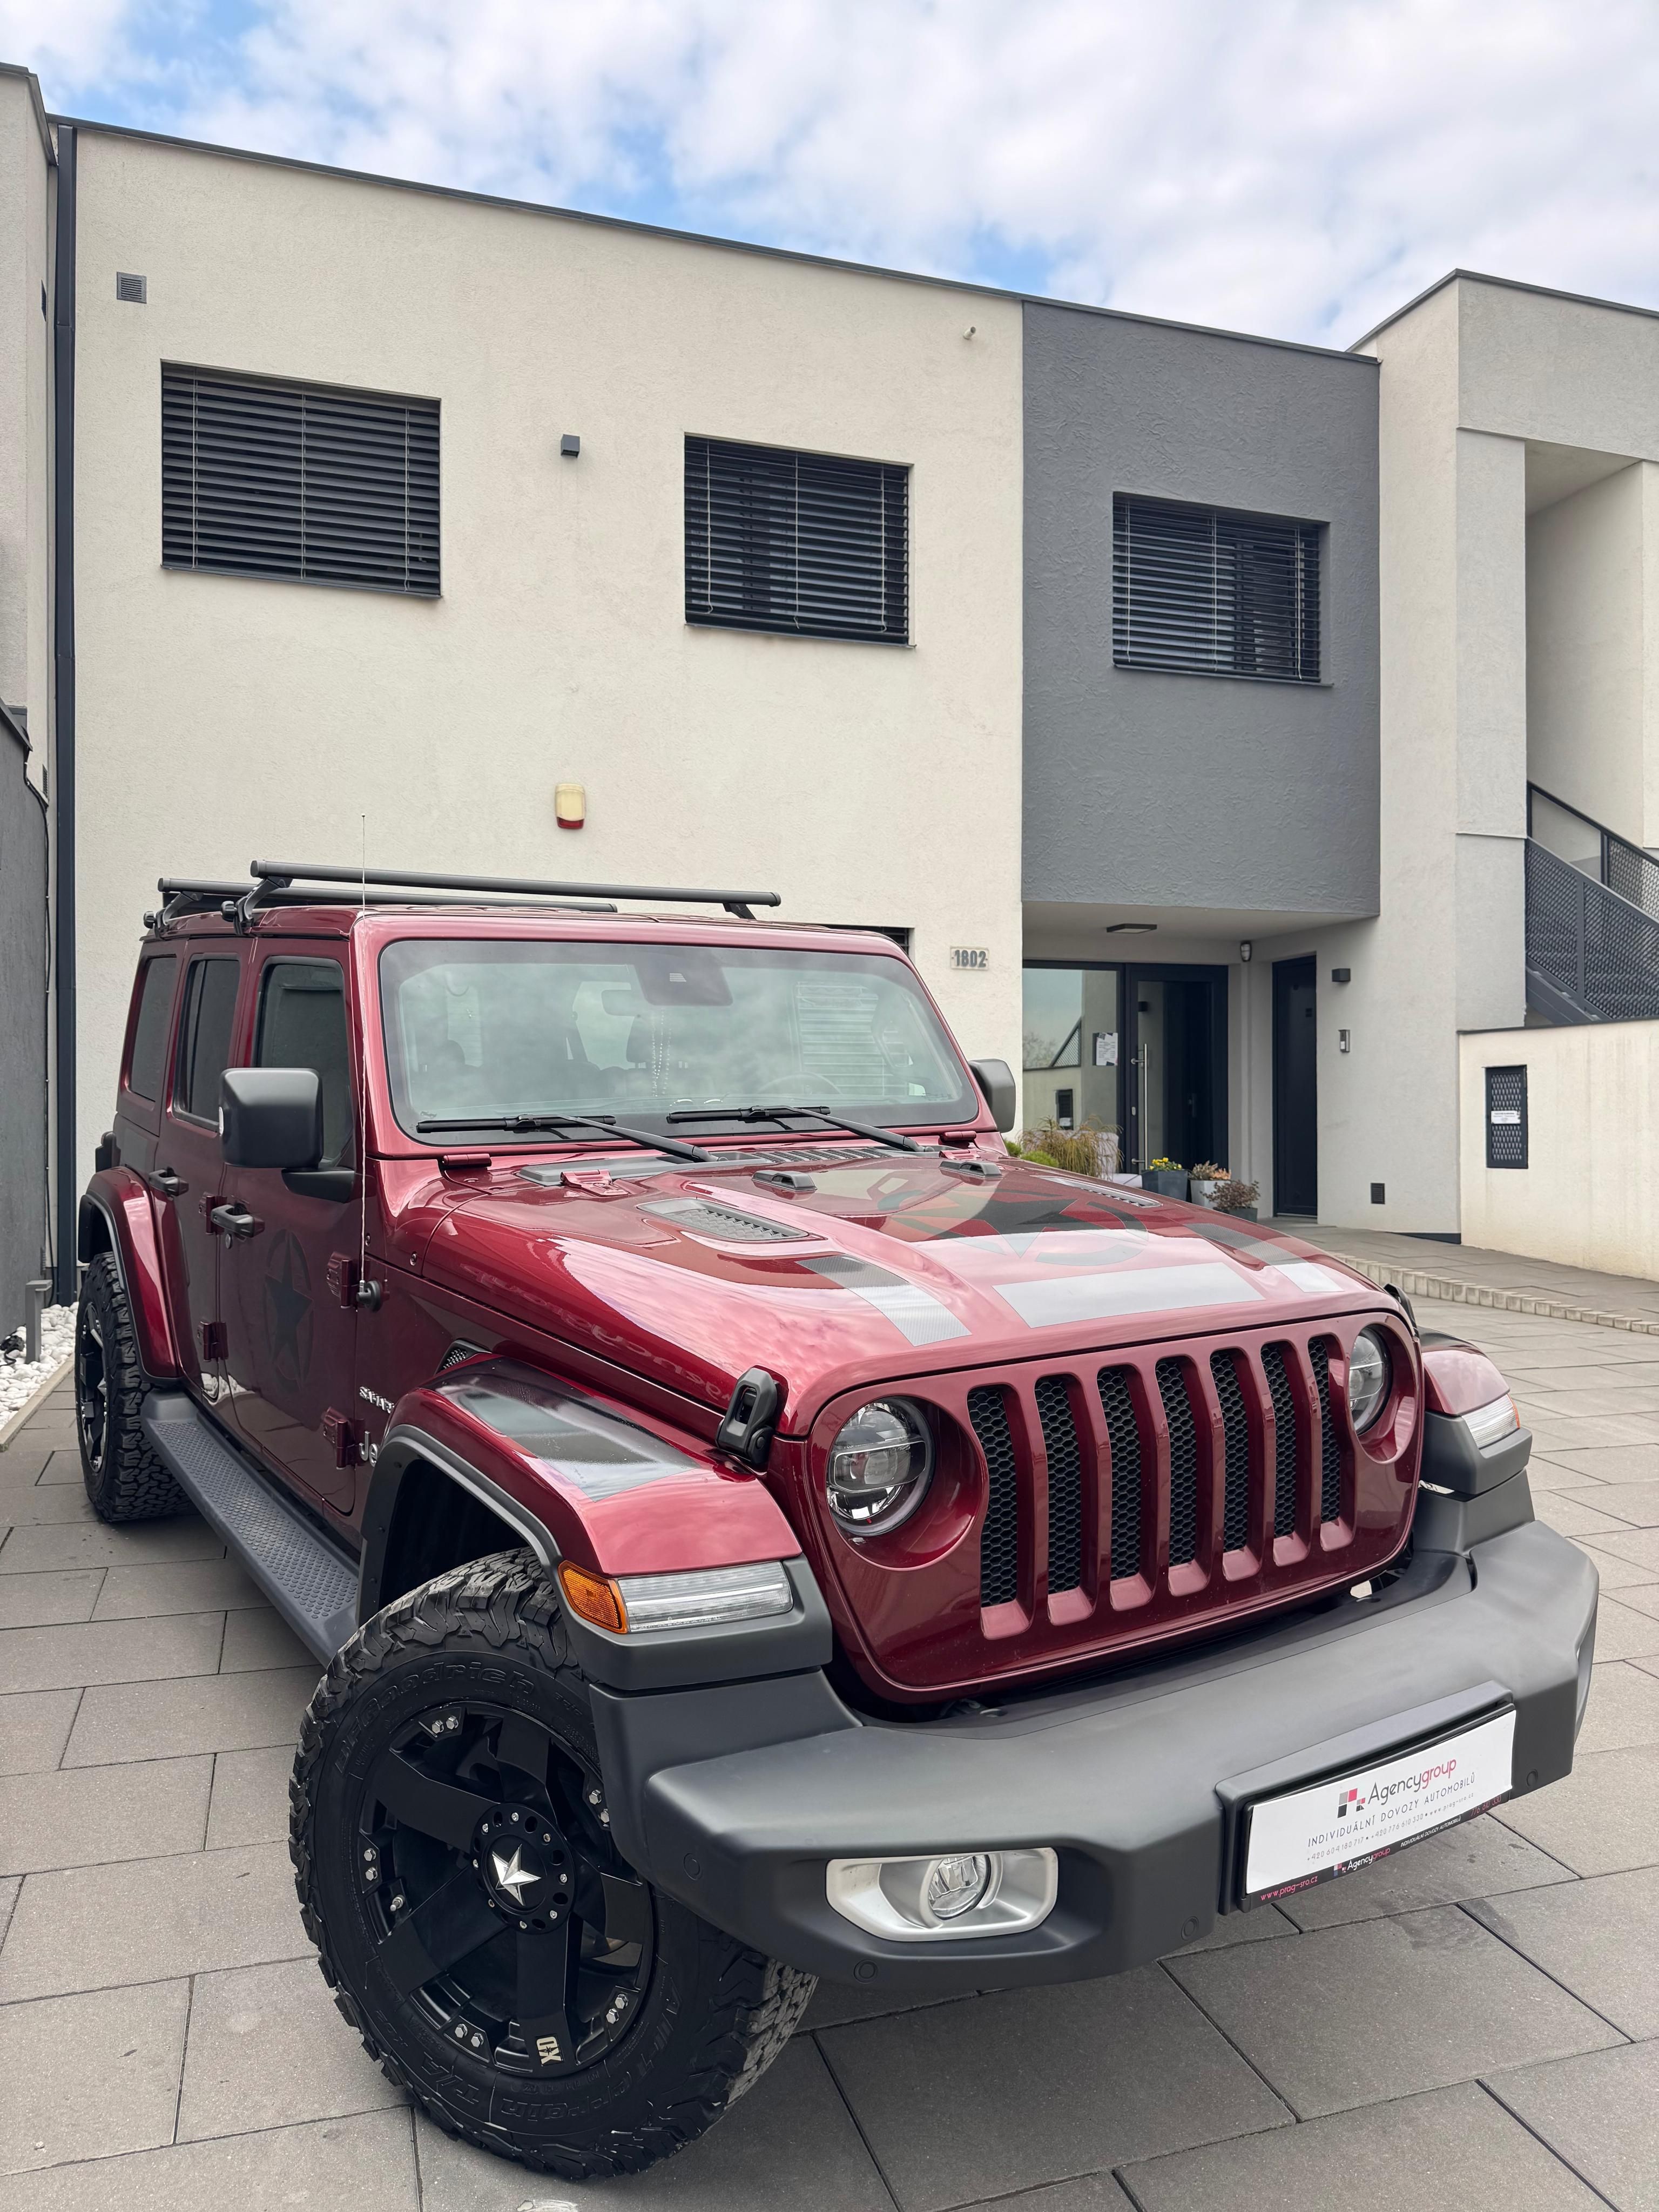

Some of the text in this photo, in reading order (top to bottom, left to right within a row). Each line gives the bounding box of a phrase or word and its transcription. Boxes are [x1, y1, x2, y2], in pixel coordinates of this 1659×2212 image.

[954, 949, 986, 968] 1802
[1367, 1758, 1457, 1805] Agencygroup
[1308, 1772, 1475, 1847] INDIVIDUÁLNÍ DOVOZY AUTOMOBILŮ
[1326, 1845, 1340, 1854] 604
[1341, 1840, 1352, 1850] 180
[1353, 1837, 1364, 1847] 717
[1388, 1824, 1400, 1835] 776
[1401, 1818, 1411, 1828] 610
[1412, 1812, 1424, 1823] 330
[1260, 1875, 1318, 1901] www.prag-sro.cz
[1347, 1847, 1391, 1871] Agencygroup
